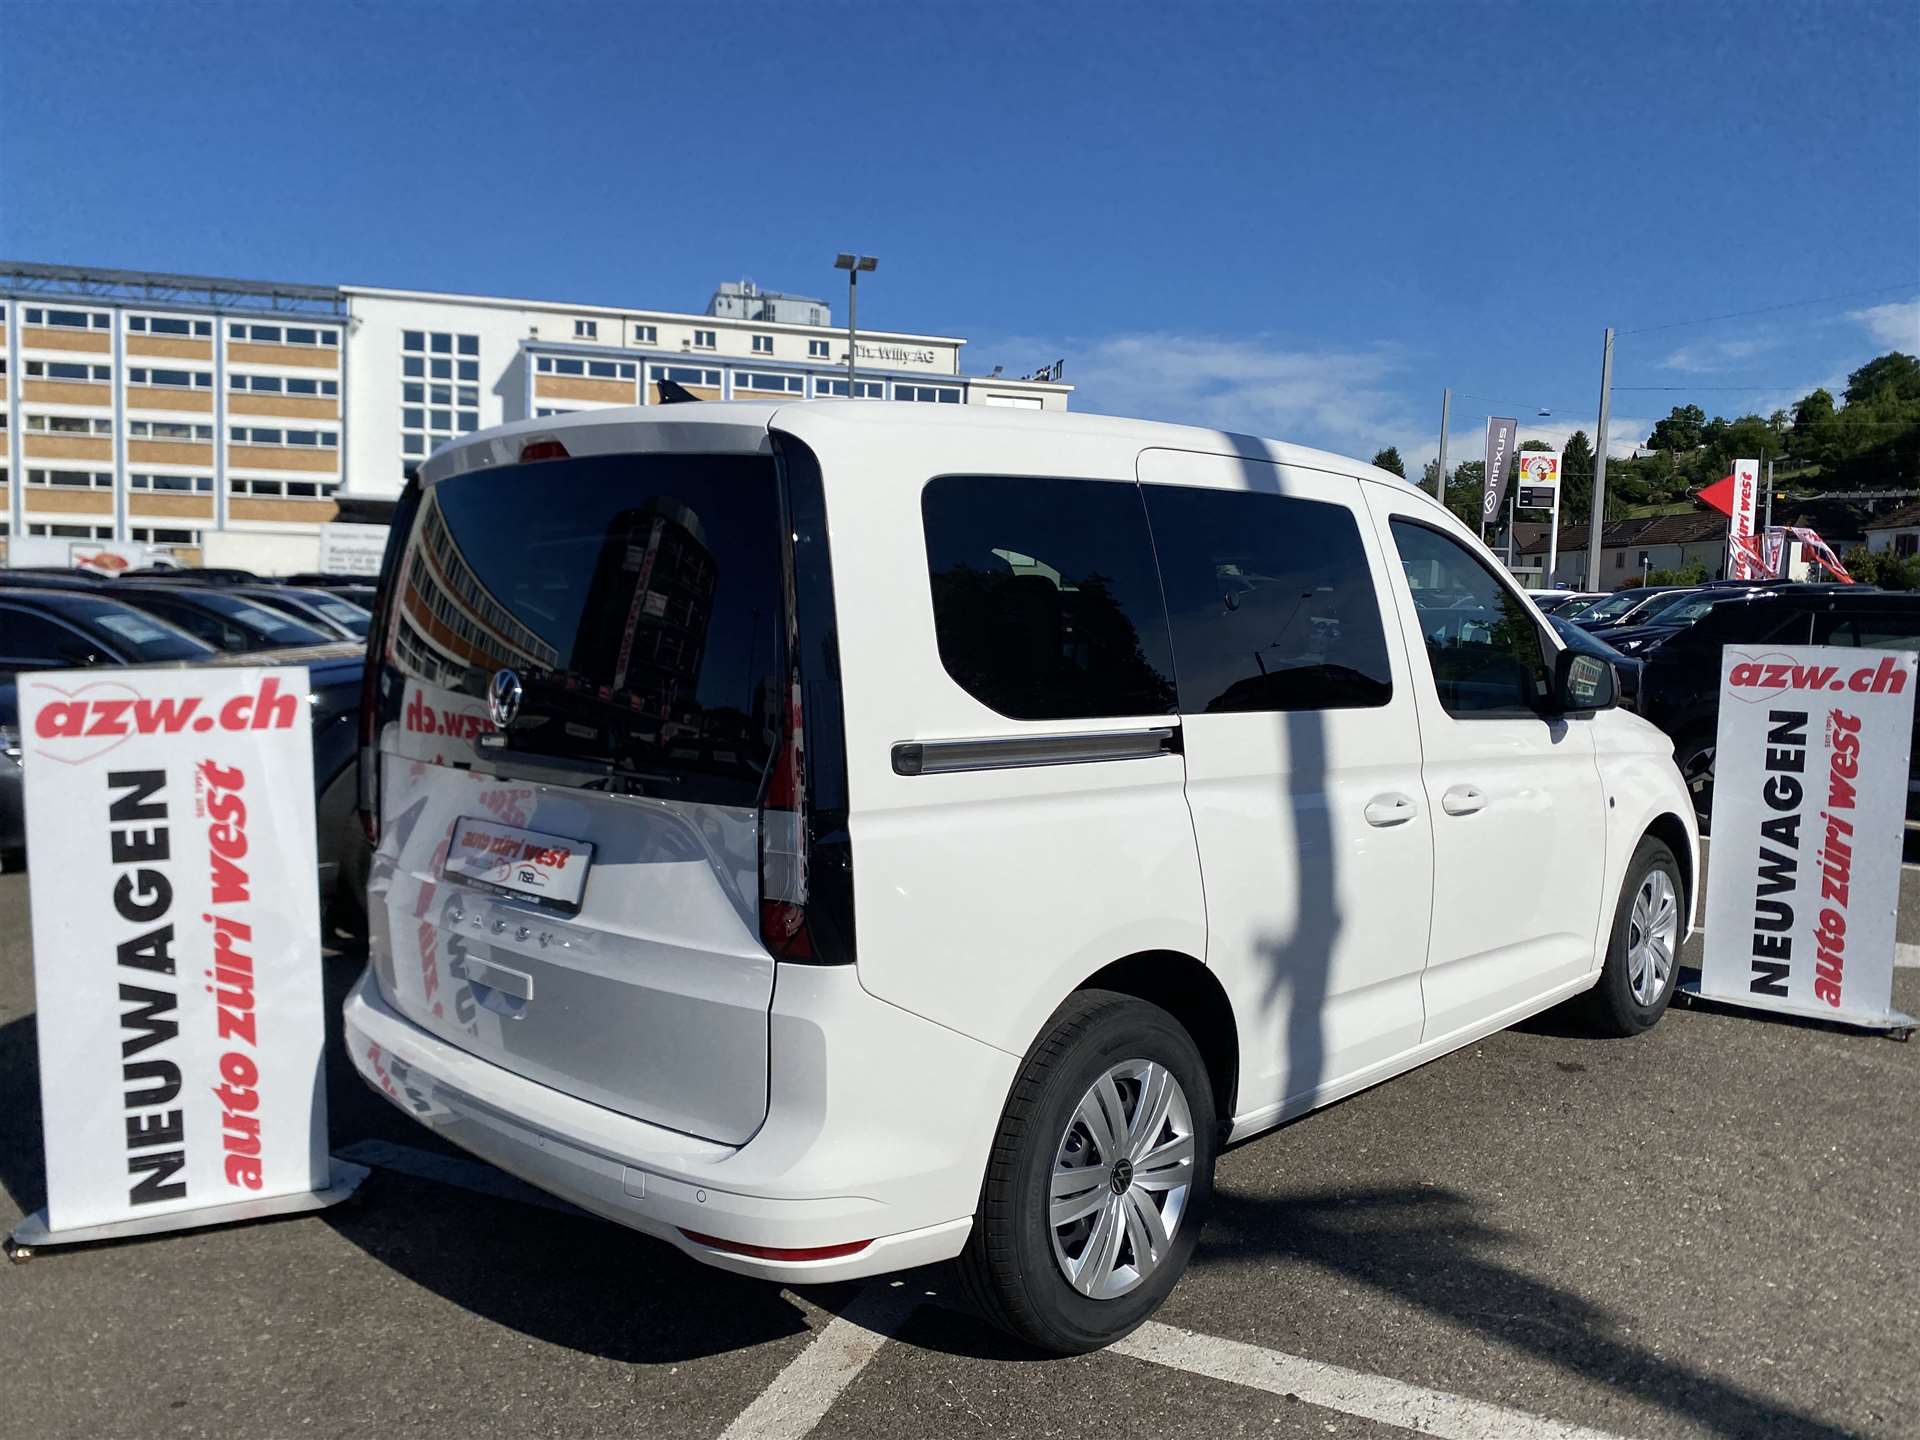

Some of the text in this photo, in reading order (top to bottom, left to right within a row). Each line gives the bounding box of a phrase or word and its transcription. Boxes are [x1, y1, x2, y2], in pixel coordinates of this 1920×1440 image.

[1739, 471, 1753, 511] west
[1736, 513, 1750, 539] üri
[1728, 657, 1908, 694] azw.ch
[35, 677, 299, 740] azw.ch
[521, 843, 572, 870] west
[1749, 709, 1809, 998] NEUWAGEN
[1813, 708, 1861, 1008] auto züri west
[107, 769, 187, 1207] NEUWAGEN
[197, 759, 263, 1192] auto züri west
